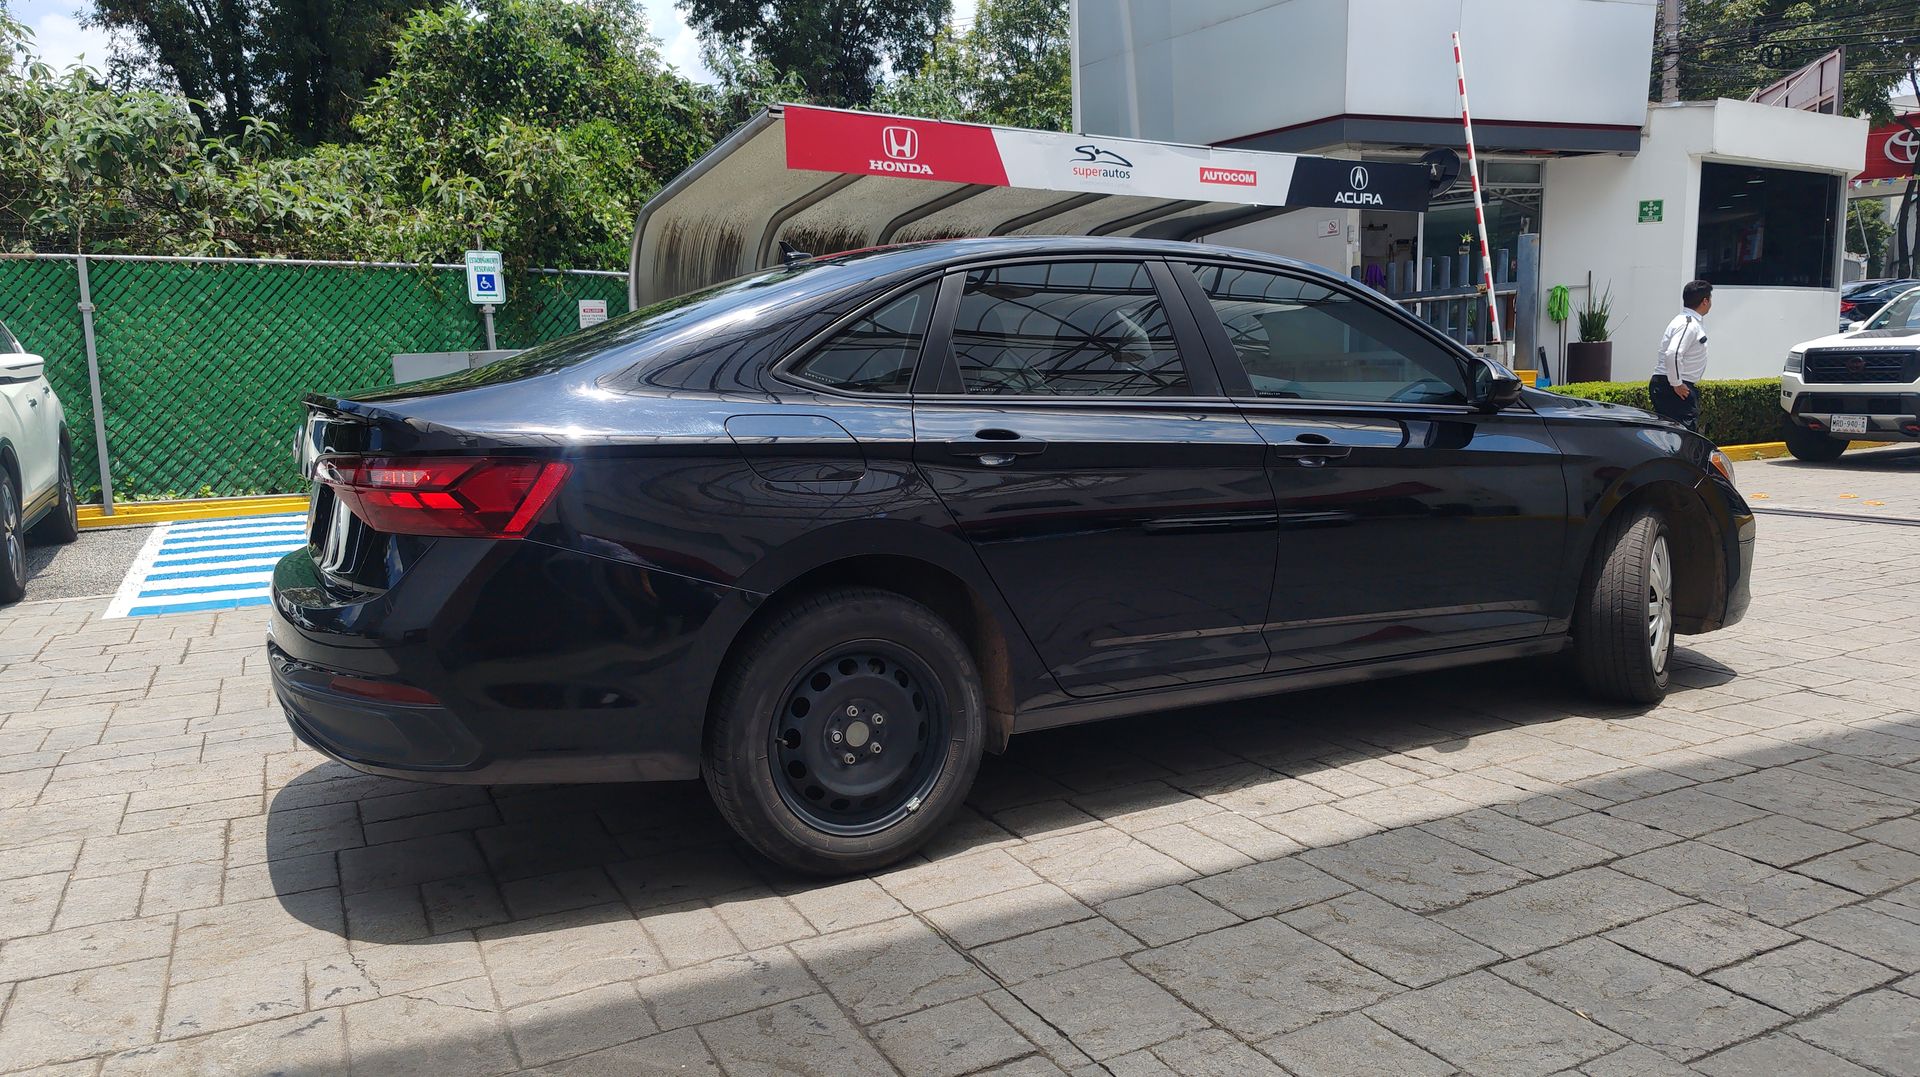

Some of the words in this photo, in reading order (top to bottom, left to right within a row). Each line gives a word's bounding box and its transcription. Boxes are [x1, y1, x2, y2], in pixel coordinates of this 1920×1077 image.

[869, 160, 933, 175] HONDA
[1073, 167, 1131, 179] superautos
[1202, 170, 1254, 183] AUTOCOM
[1334, 192, 1383, 205] ACURA
